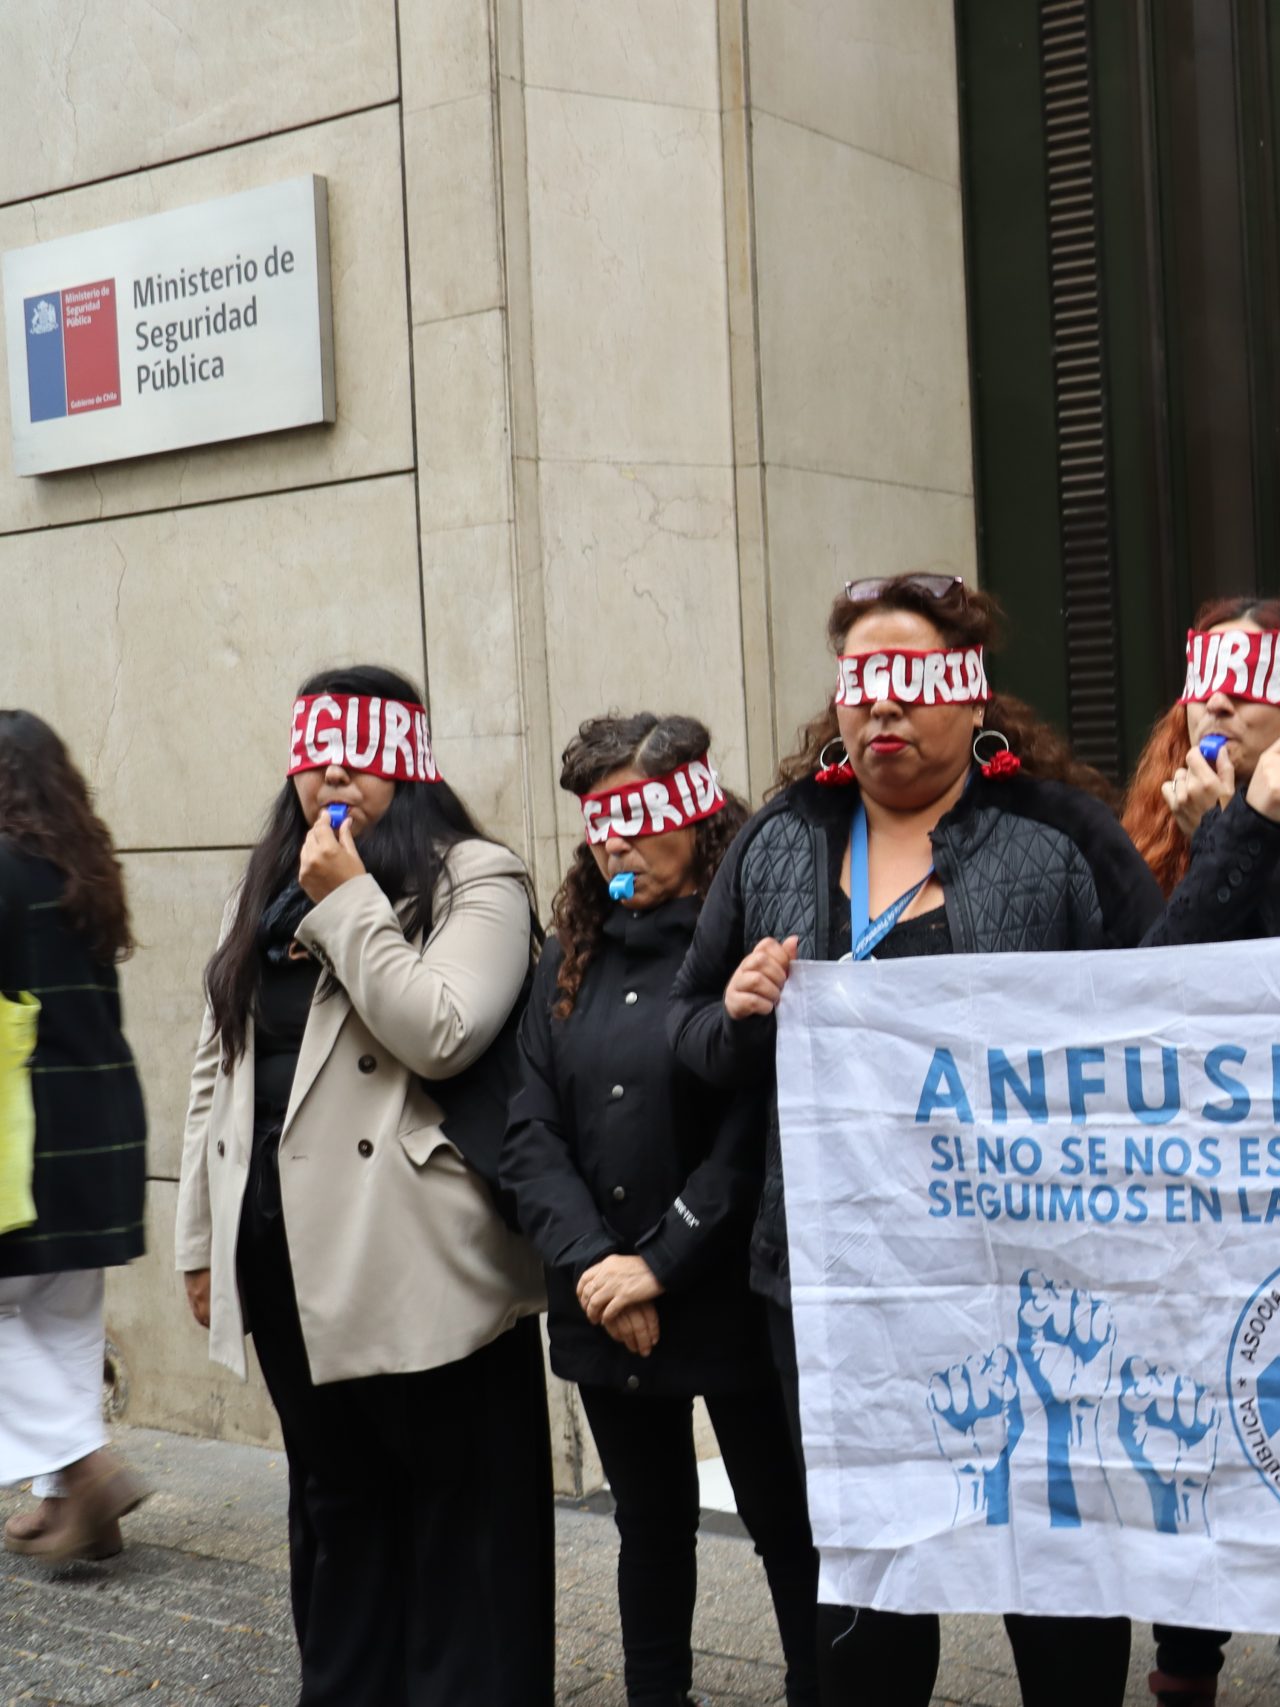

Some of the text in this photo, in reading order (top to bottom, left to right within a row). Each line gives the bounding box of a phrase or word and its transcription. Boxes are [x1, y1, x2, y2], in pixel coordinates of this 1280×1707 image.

[65, 286, 110, 304] Ministerio de
[133, 245, 295, 309] Ministerio de
[66, 299, 101, 316] Seguridad
[66, 314, 92, 328] Pública
[136, 296, 258, 353] Seguridad
[136, 353, 225, 394] Pública
[70, 396, 95, 409] Gobierno
[103, 391, 117, 402] Chile
[583, 757, 724, 844] GURID
[930, 1135, 965, 1172] SI
[978, 1135, 1043, 1176] NO
[1060, 1136, 1109, 1176] SE
[1123, 1137, 1221, 1177] NOS
[927, 1180, 1148, 1224] SEGUIMOS
[1165, 1185, 1223, 1225] EN
